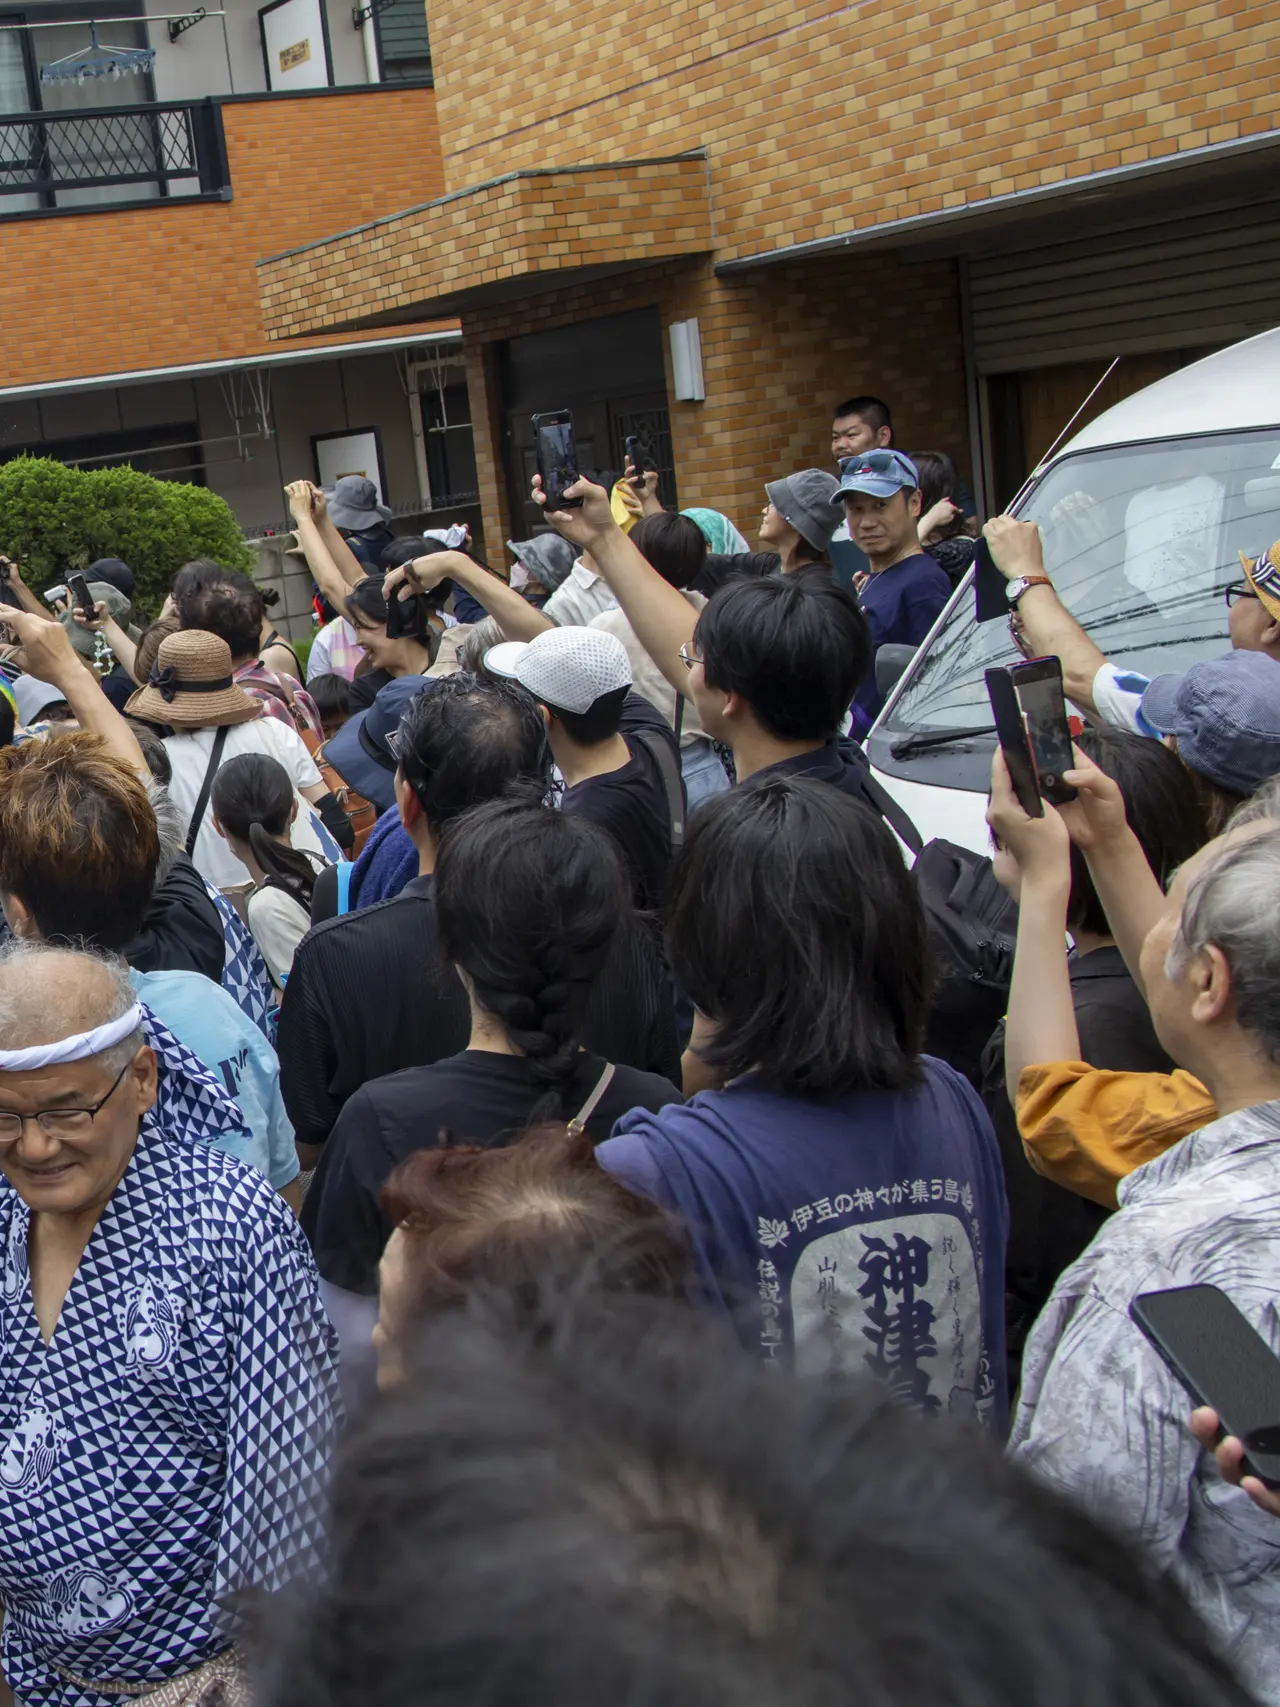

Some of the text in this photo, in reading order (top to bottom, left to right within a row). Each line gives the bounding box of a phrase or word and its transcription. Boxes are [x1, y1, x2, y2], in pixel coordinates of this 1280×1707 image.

[790, 1177, 960, 1233] 伊豆の神々が集う島
